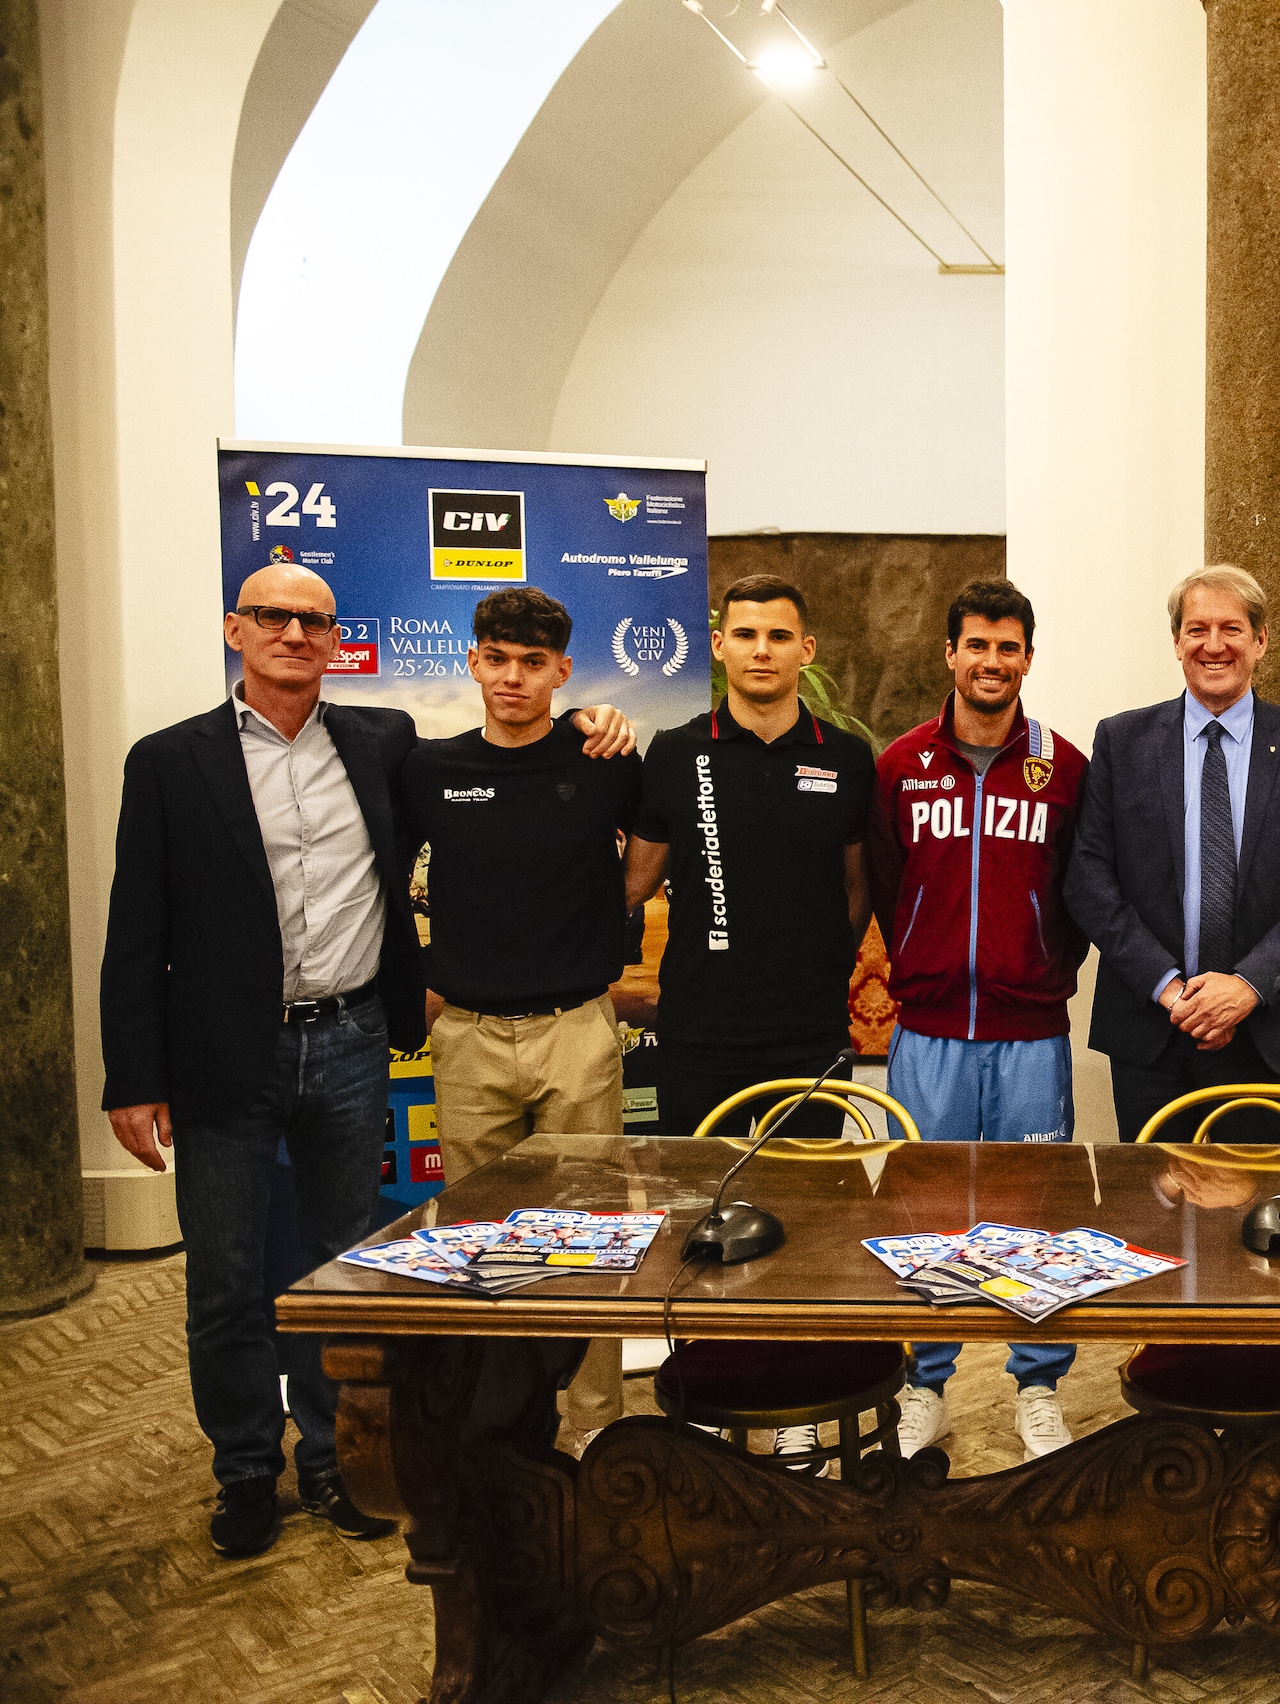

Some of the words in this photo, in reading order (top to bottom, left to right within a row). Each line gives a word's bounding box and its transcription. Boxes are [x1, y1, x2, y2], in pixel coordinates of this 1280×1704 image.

[250, 501, 261, 542] www.civ.tv
[443, 511, 512, 532] CIV
[455, 560, 514, 568] DUNLOP
[561, 553, 627, 565] Autodromo
[629, 554, 689, 567] Vallelunga
[608, 568, 632, 577] Piero
[633, 569, 662, 578] Taruffi
[356, 623, 369, 640] 2
[390, 616, 454, 635] ROMA
[632, 626, 666, 638] VENI
[634, 638, 665, 649] VIDI
[637, 650, 664, 661] CIV
[902, 778, 939, 792] Allianz
[911, 794, 1048, 844] POLIZIA
[695, 754, 728, 927] scuderiadettorre
[630, 1100, 654, 1108] Power
[1023, 1129, 1059, 1142] Allianz
